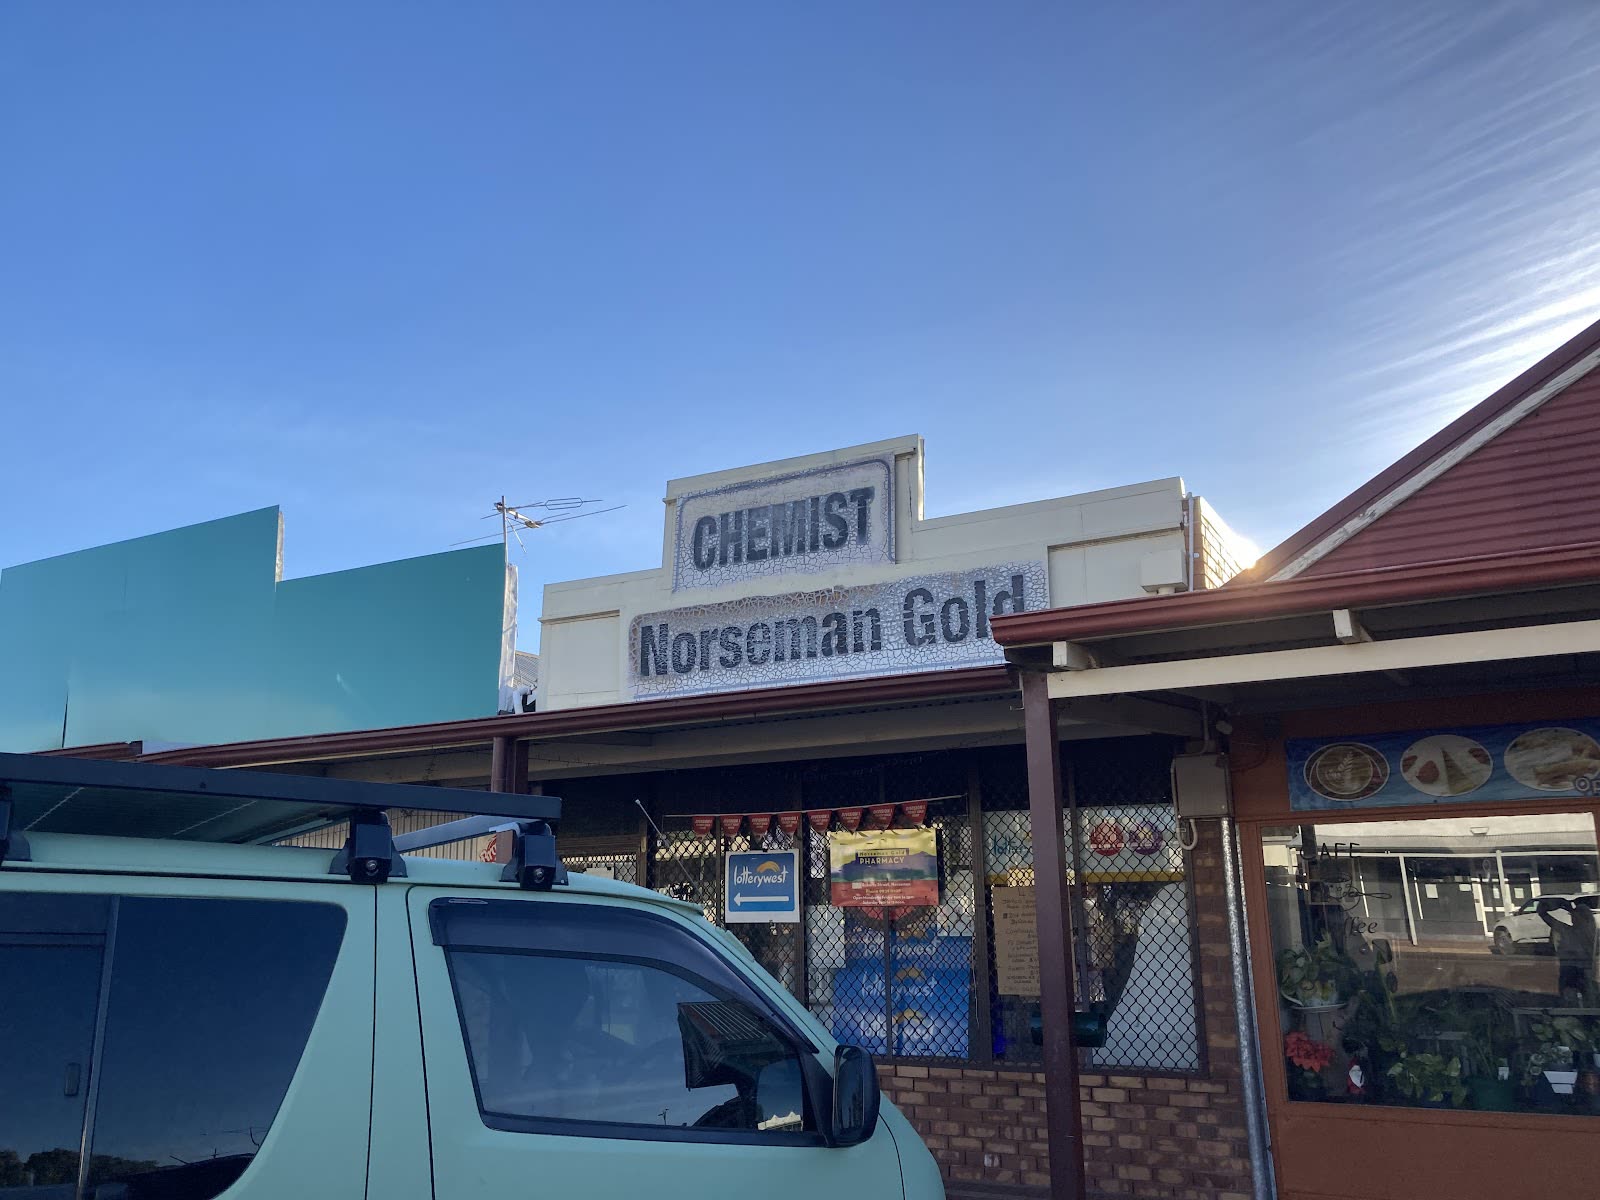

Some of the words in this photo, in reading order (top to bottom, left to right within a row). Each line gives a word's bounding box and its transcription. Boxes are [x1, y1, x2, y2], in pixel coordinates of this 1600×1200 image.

[692, 485, 876, 572] CHEMIST
[640, 606, 882, 677] Norseman
[903, 574, 1025, 647] Gold
[733, 865, 789, 888] lotterywest
[859, 856, 905, 865] PHARMACY
